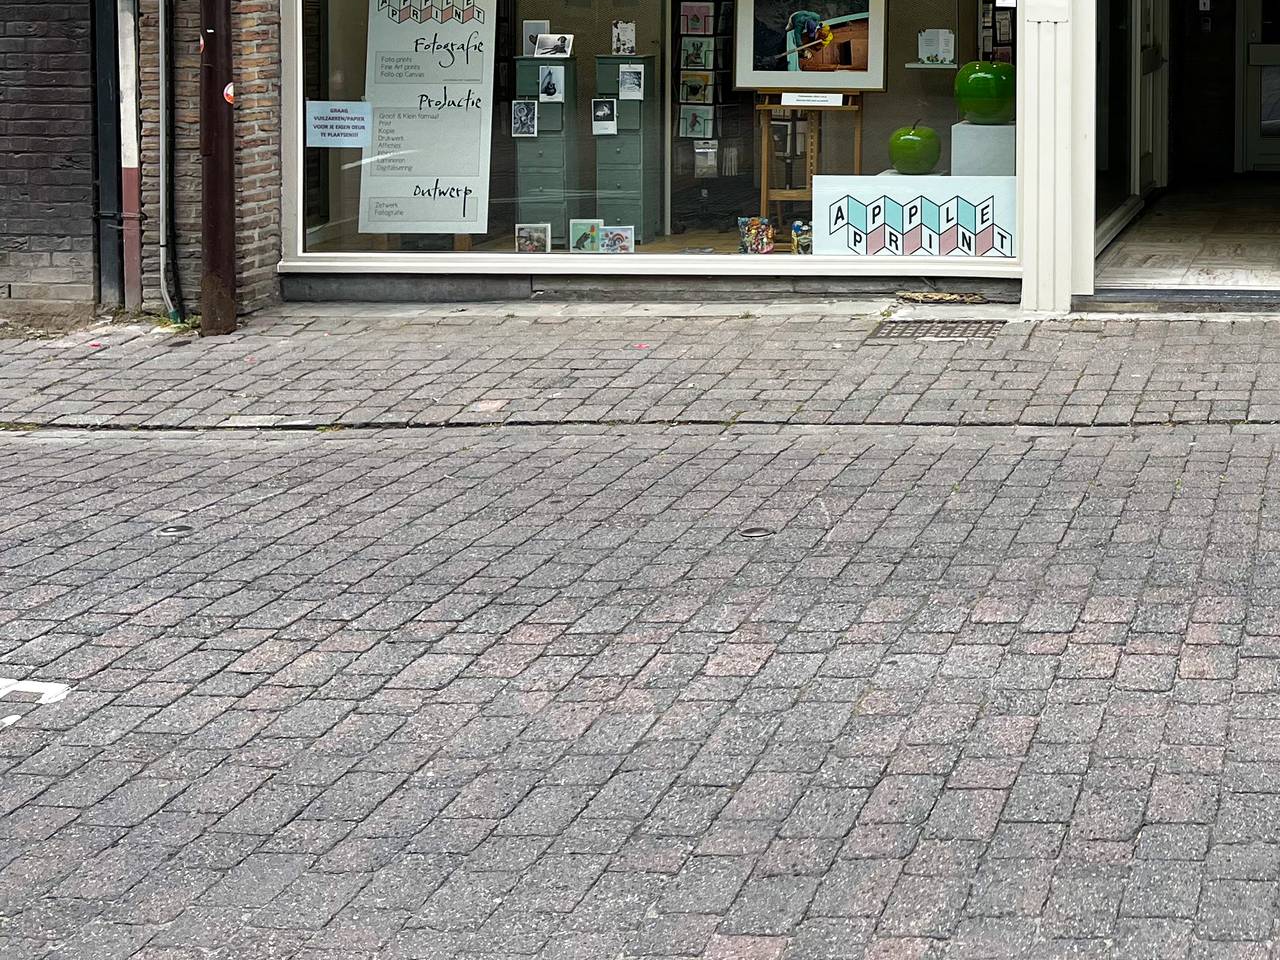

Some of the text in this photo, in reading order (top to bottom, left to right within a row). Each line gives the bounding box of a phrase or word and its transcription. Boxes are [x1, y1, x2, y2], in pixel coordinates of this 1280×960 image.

[391, 9, 482, 20] PRINT
[414, 31, 484, 68] Fotografie
[418, 86, 482, 112] Productie
[413, 178, 473, 217] Ontwerp
[834, 204, 990, 226] APPLE
[853, 230, 1007, 252] PRINT
